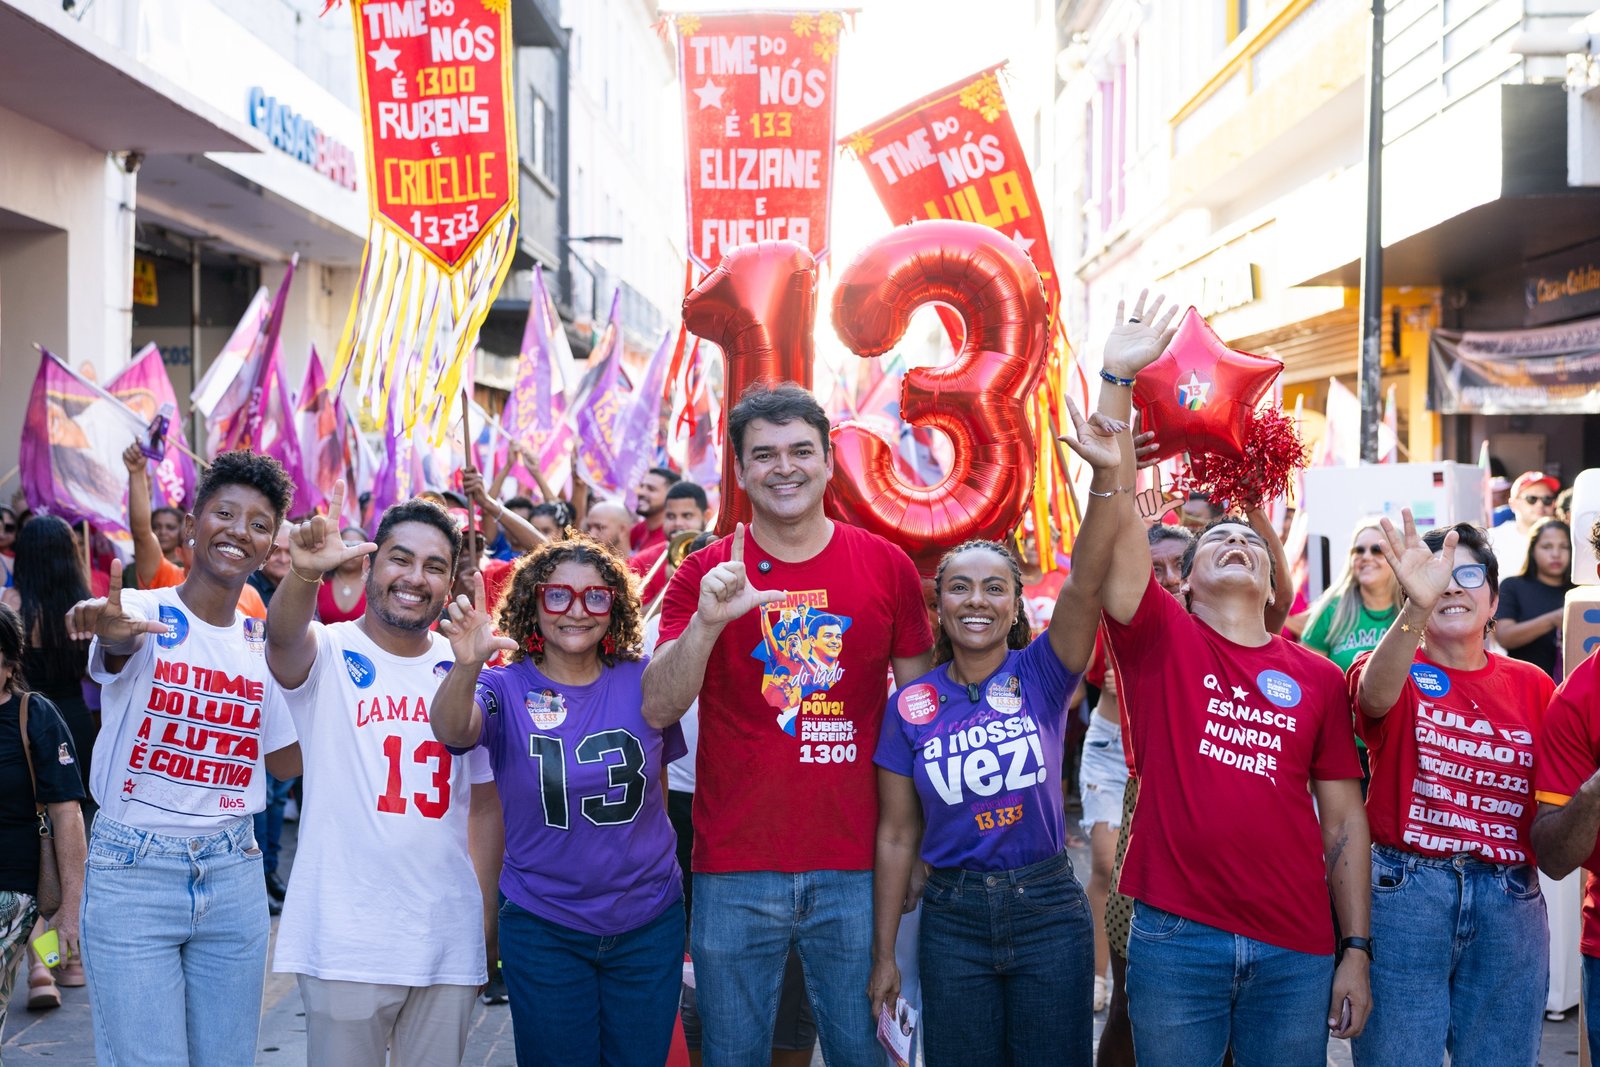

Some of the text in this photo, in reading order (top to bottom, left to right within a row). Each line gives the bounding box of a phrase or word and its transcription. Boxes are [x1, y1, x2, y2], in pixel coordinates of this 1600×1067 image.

[363, 0, 428, 40] TIME
[431, 18, 495, 62] NÓS
[690, 35, 787, 75] TIME DO
[391, 65, 475, 99] É 1300
[759, 57, 827, 108] NÓS
[378, 96, 489, 140] RUBENS
[725, 108, 793, 139] É 133
[430, 141, 442, 157] E
[869, 116, 959, 185] TIME DO
[938, 130, 1005, 189] NÓS
[699, 148, 821, 189] ELIZIANE
[755, 196, 767, 216] E
[410, 204, 479, 247] 13333
[1187, 385, 1202, 397] 13
[154, 658, 264, 702] NO TIME
[791, 661, 845, 687] do lado
[1203, 674, 1222, 693] Q
[147, 687, 262, 730] DO LULA
[811, 693, 826, 701] DO
[910, 704, 936, 719] 1300
[1267, 689, 1292, 701] 1300
[802, 720, 854, 732] RUBENS
[802, 731, 854, 742] PEREIRA
[1417, 703, 1495, 736] LULA
[137, 717, 259, 761] A LUTA
[799, 743, 857, 764] 1300
[923, 737, 942, 760] a
[949, 715, 1037, 754] nossa
[129, 743, 254, 788] É COLETIVA
[377, 735, 452, 819] 13
[1518, 751, 1534, 768] 13
[529, 728, 647, 830] 13
[1475, 770, 1529, 795] 13.333
[1454, 791, 1468, 807] JR
[1470, 795, 1524, 818] 1300
[1408, 804, 1518, 841] ELIZIANE 133
